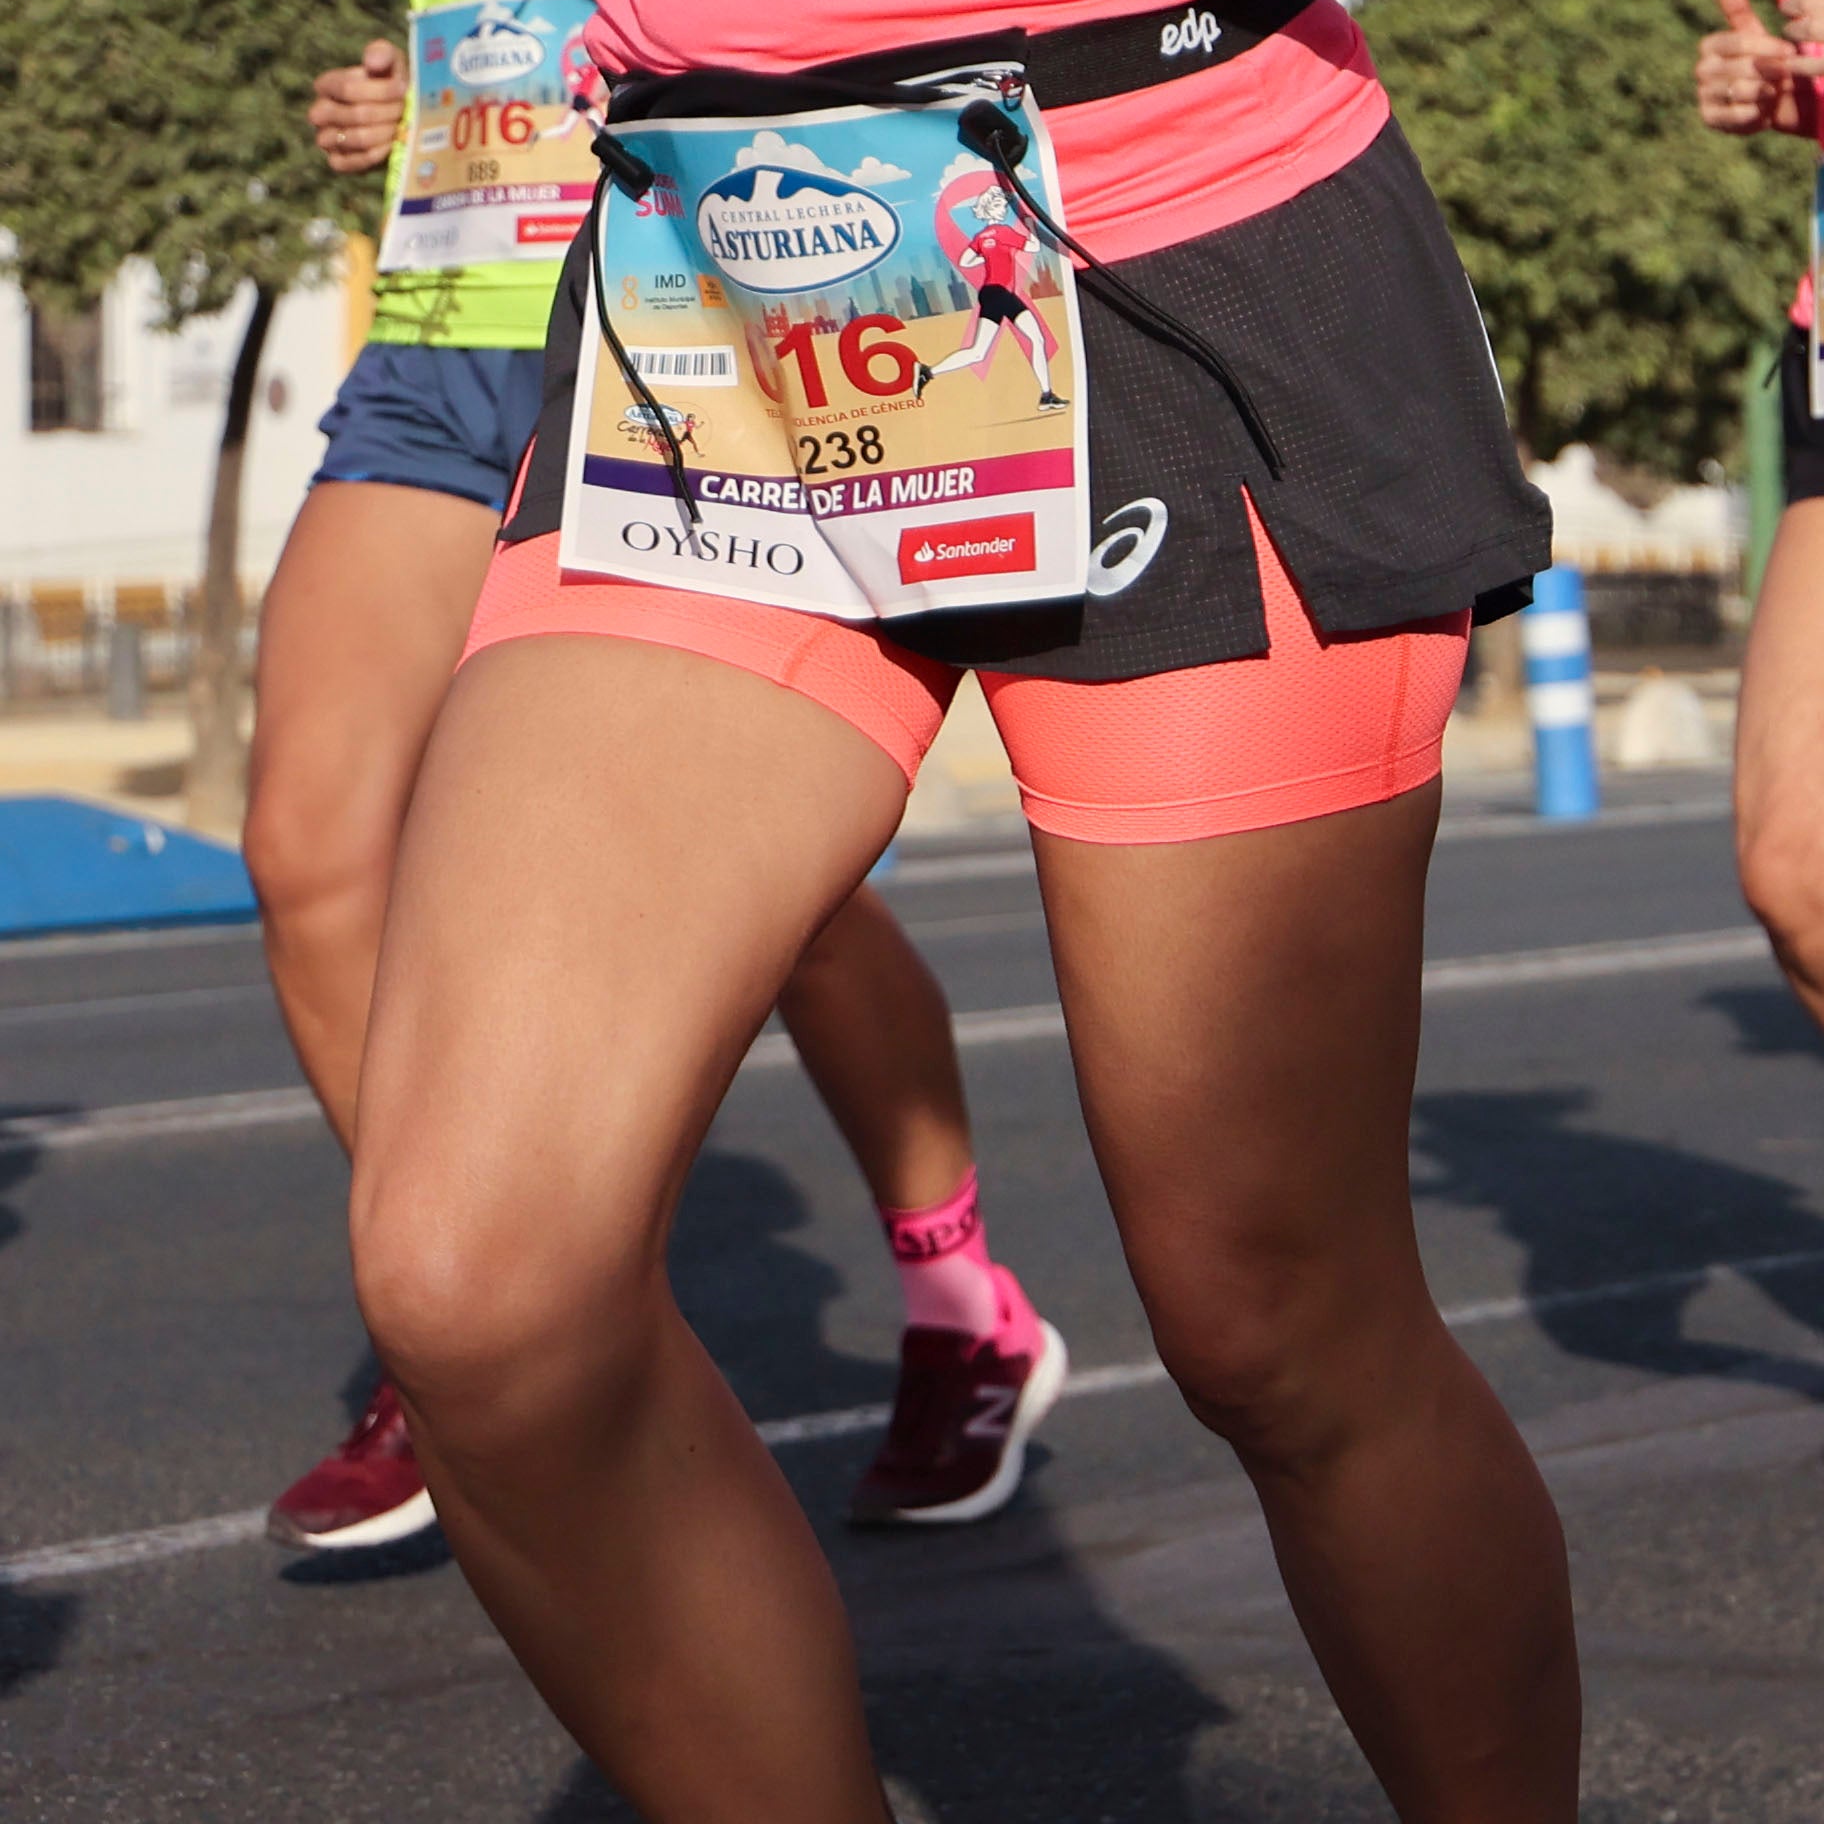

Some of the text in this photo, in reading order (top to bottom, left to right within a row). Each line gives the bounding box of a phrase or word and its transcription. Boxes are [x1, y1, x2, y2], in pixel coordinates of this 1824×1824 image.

[1160, 7, 1222, 56] edp
[451, 98, 536, 151] 016
[707, 212, 885, 261] ASTURIANA
[720, 201, 867, 224] CENTRAL LECHERA
[654, 273, 687, 289] IMD
[795, 412, 849, 428] OLENCIA
[850, 407, 869, 419] DE
[871, 398, 926, 415] GÉNERO
[792, 424, 885, 475] 238
[811, 484, 846, 515] DE
[852, 479, 884, 510] LA
[890, 466, 975, 504] MUJER
[621, 520, 803, 577] OYSHO
[935, 536, 1017, 561] Santander
